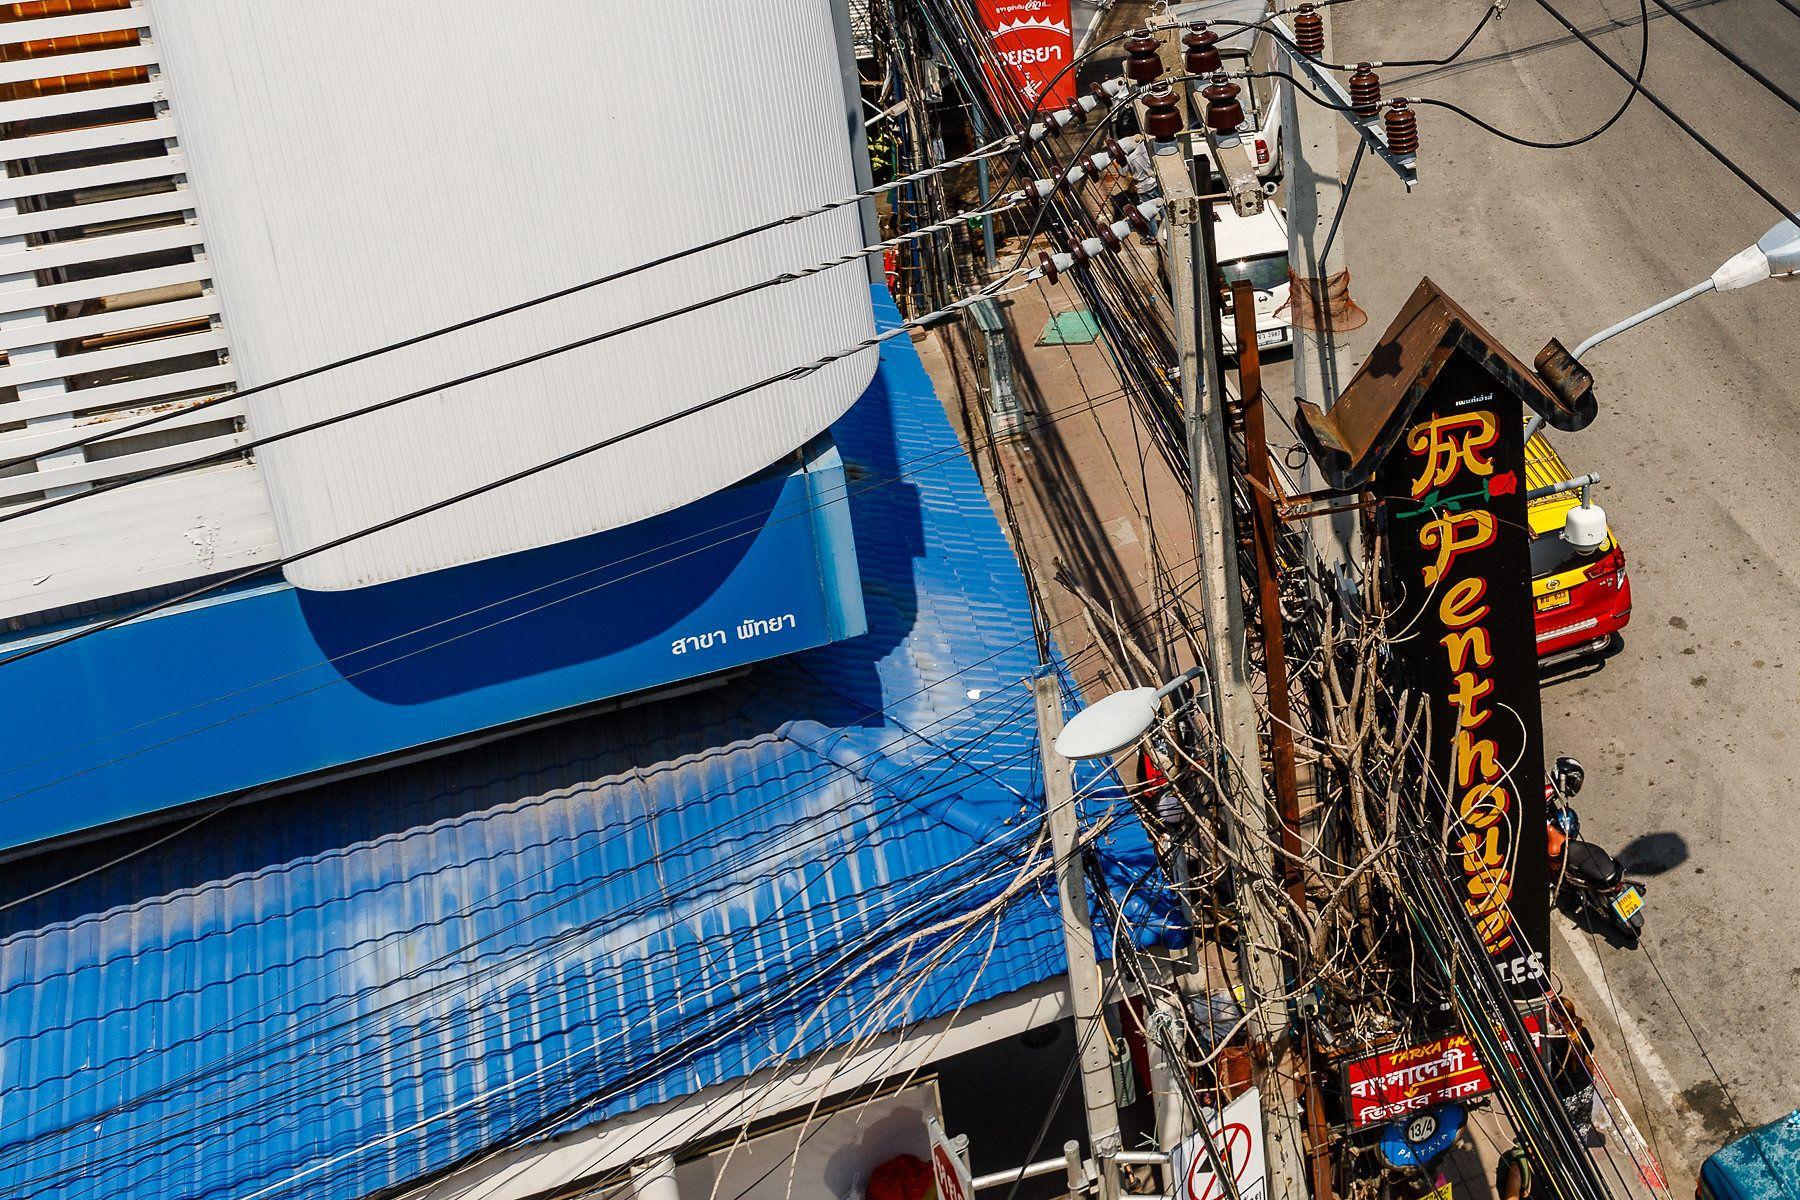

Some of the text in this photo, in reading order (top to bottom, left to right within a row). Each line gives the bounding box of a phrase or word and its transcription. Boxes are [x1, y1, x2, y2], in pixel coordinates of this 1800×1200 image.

[1406, 409, 1500, 498] R
[671, 613, 796, 655] สาขา พัทยา
[1389, 1041, 1442, 1066] TARKA
[1409, 1118, 1435, 1138] 13/4
